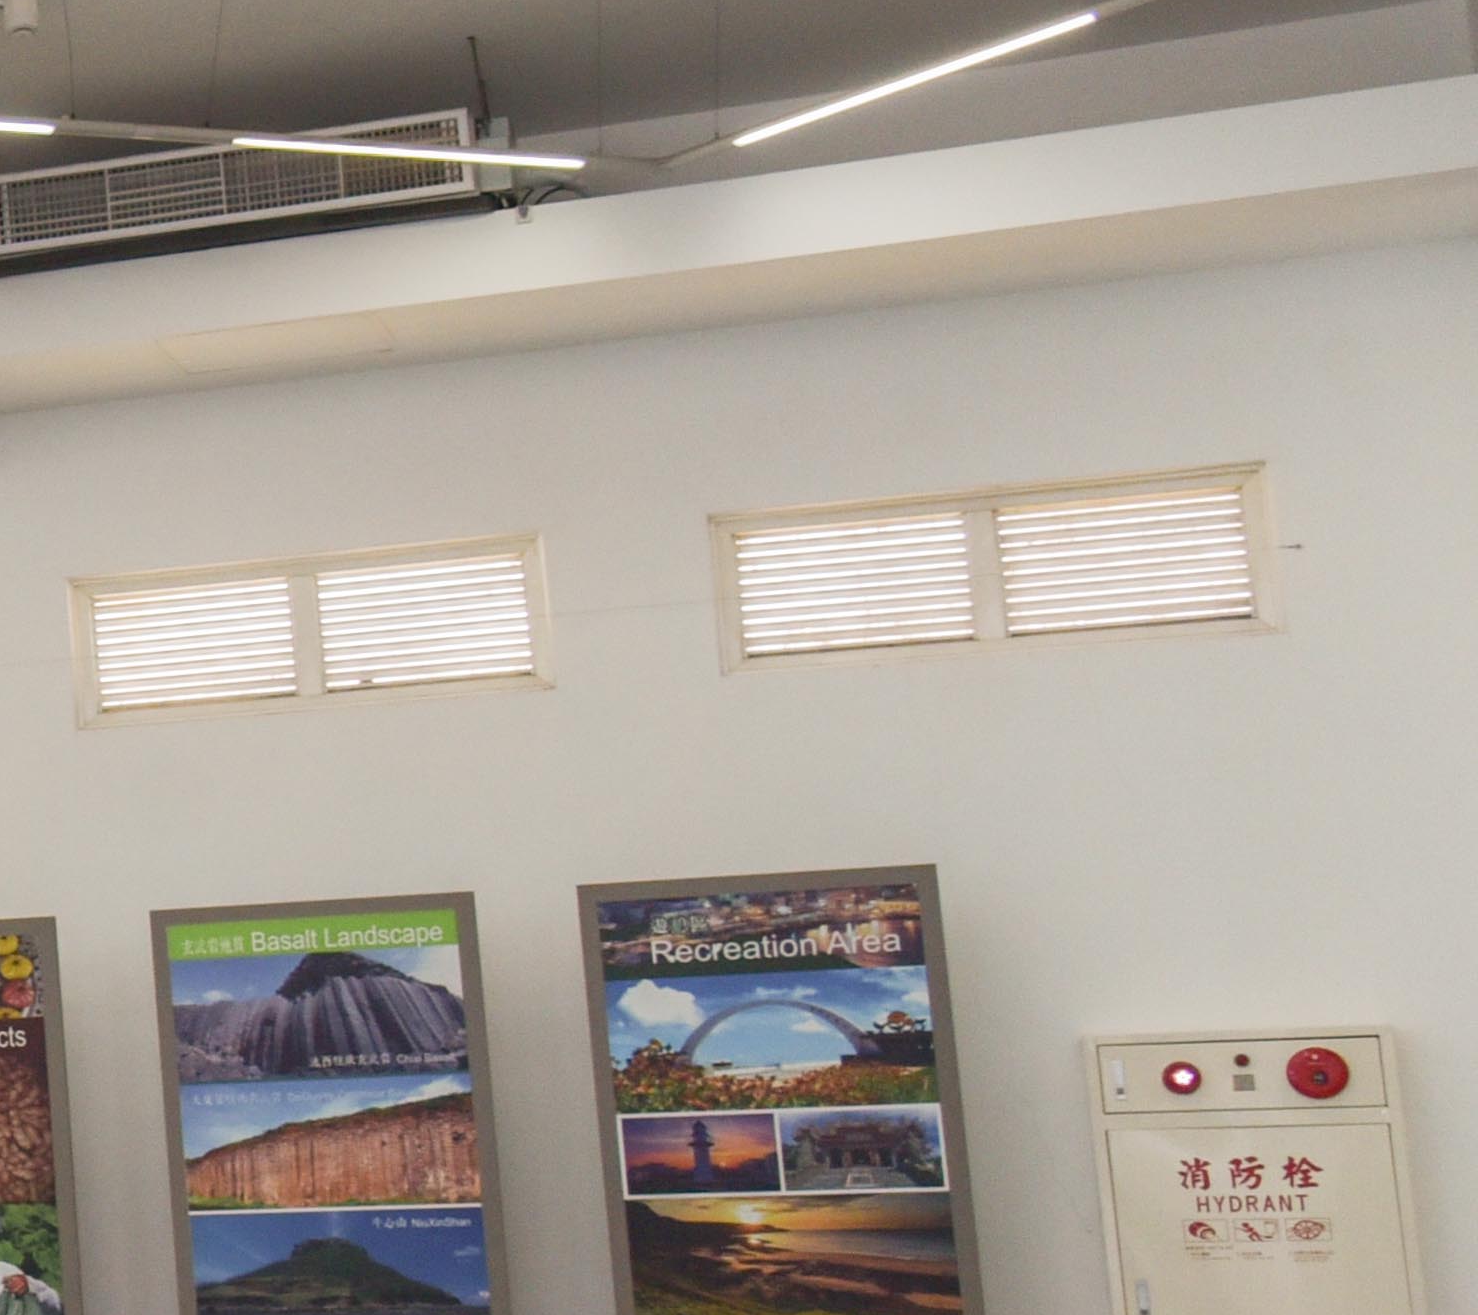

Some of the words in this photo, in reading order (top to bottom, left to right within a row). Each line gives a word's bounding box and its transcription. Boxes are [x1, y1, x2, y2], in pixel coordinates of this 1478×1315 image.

[251, 929, 319, 953] Basalt
[324, 924, 444, 949] Landscape
[650, 934, 817, 965] Recreation
[826, 930, 902, 956] Area
[1178, 1155, 1324, 1191] 消防栓
[1196, 1193, 1309, 1214] HYDRANT
